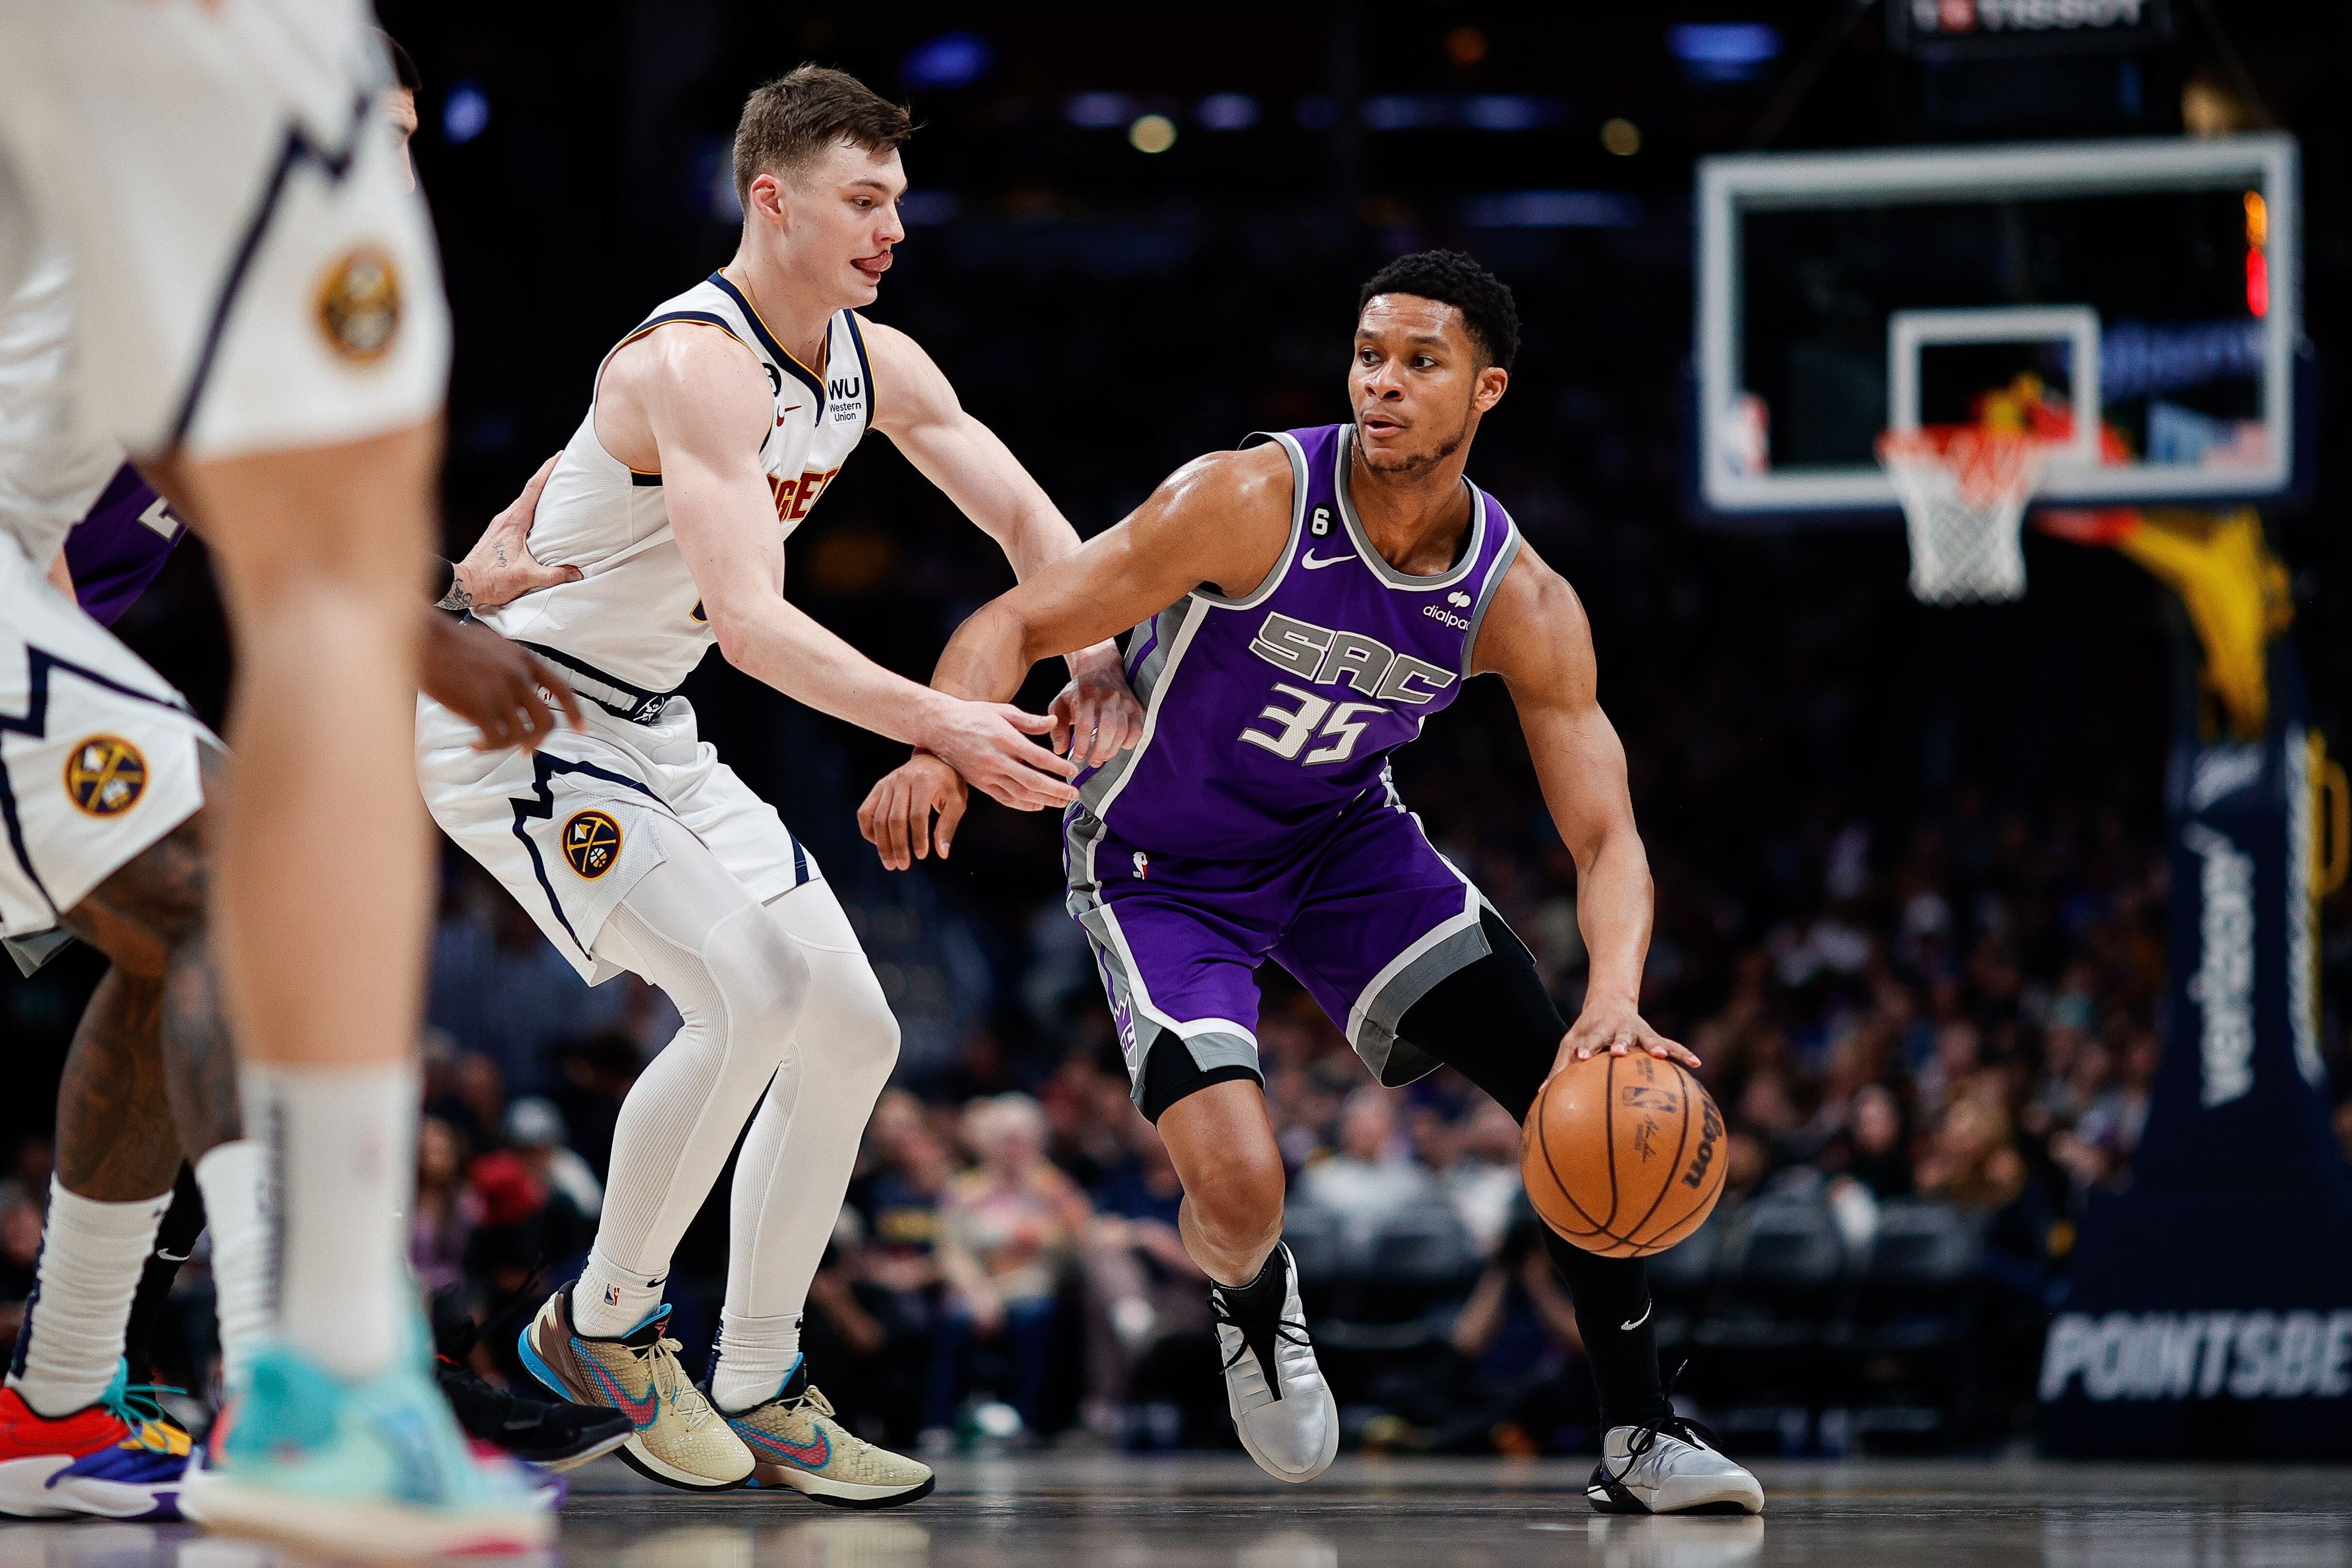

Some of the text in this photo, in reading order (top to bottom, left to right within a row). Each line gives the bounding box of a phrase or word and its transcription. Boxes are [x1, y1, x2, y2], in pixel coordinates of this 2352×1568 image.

[828, 377, 860, 400] WU
[829, 402, 862, 412] Western
[834, 411, 856, 421] Union
[1312, 508, 1329, 535] 6
[1248, 611, 1458, 705] SAC
[1237, 682, 1394, 767] 35
